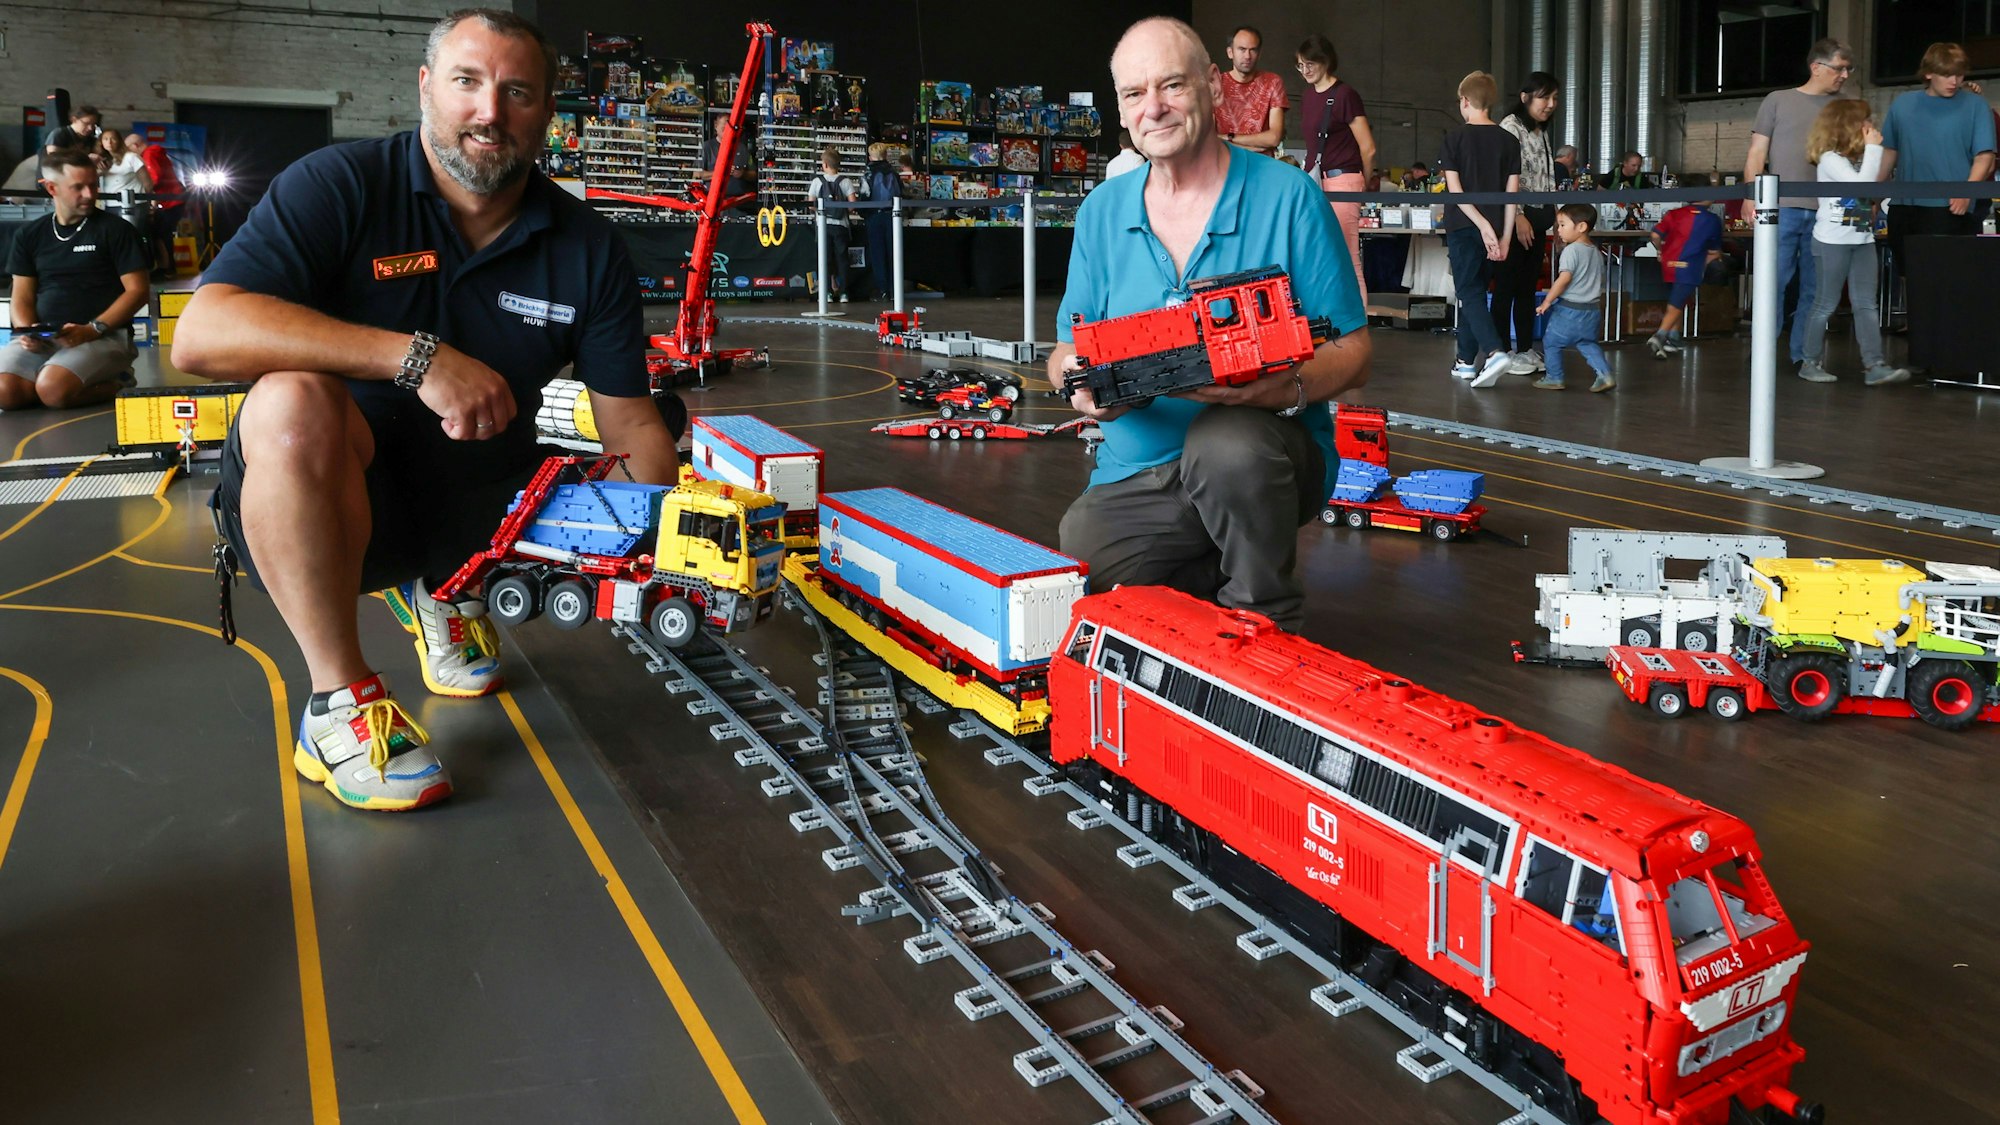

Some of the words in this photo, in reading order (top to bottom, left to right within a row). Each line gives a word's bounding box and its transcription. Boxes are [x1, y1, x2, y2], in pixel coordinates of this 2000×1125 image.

[718, 289, 735, 299] toys
[737, 289, 752, 297] and
[1310, 806, 1335, 839] LT
[1303, 836, 1317, 853] 219
[1318, 845, 1344, 869] 002-5
[1458, 935, 1464, 950] 1
[1691, 966, 1710, 986] 219
[1710, 952, 1743, 979] 002-5
[1732, 981, 1761, 1012] LT
